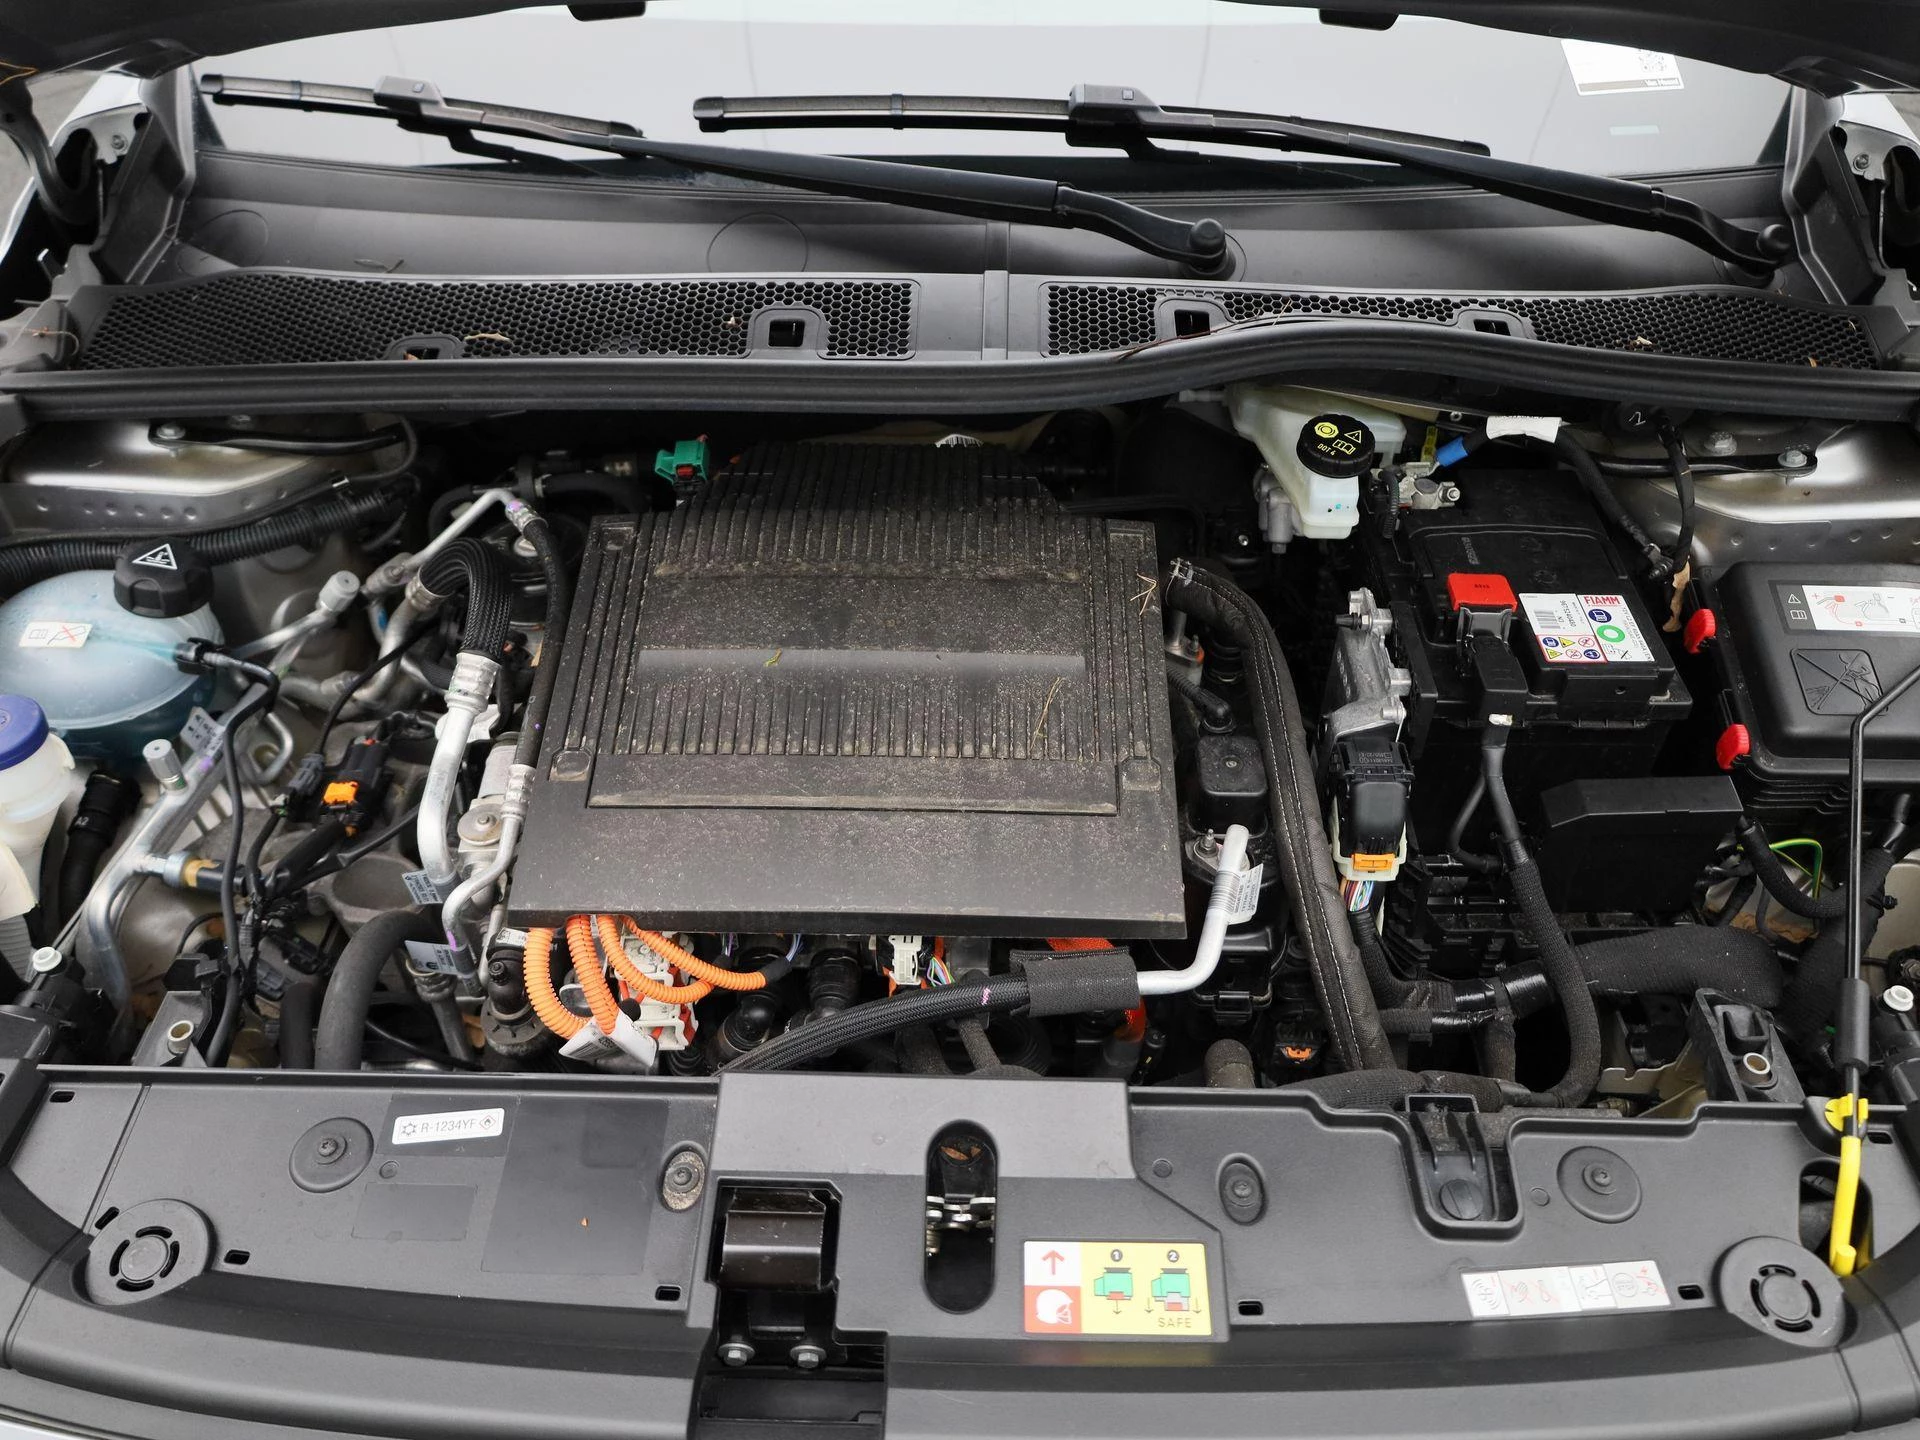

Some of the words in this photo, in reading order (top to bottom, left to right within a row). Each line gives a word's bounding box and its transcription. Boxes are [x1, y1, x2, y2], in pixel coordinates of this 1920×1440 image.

[1317, 444, 1331, 452] DOT
[1583, 596, 1620, 604] FIAMM
[420, 1119, 477, 1133] R-1234YF
[1158, 1317, 1192, 1328] SAFE
